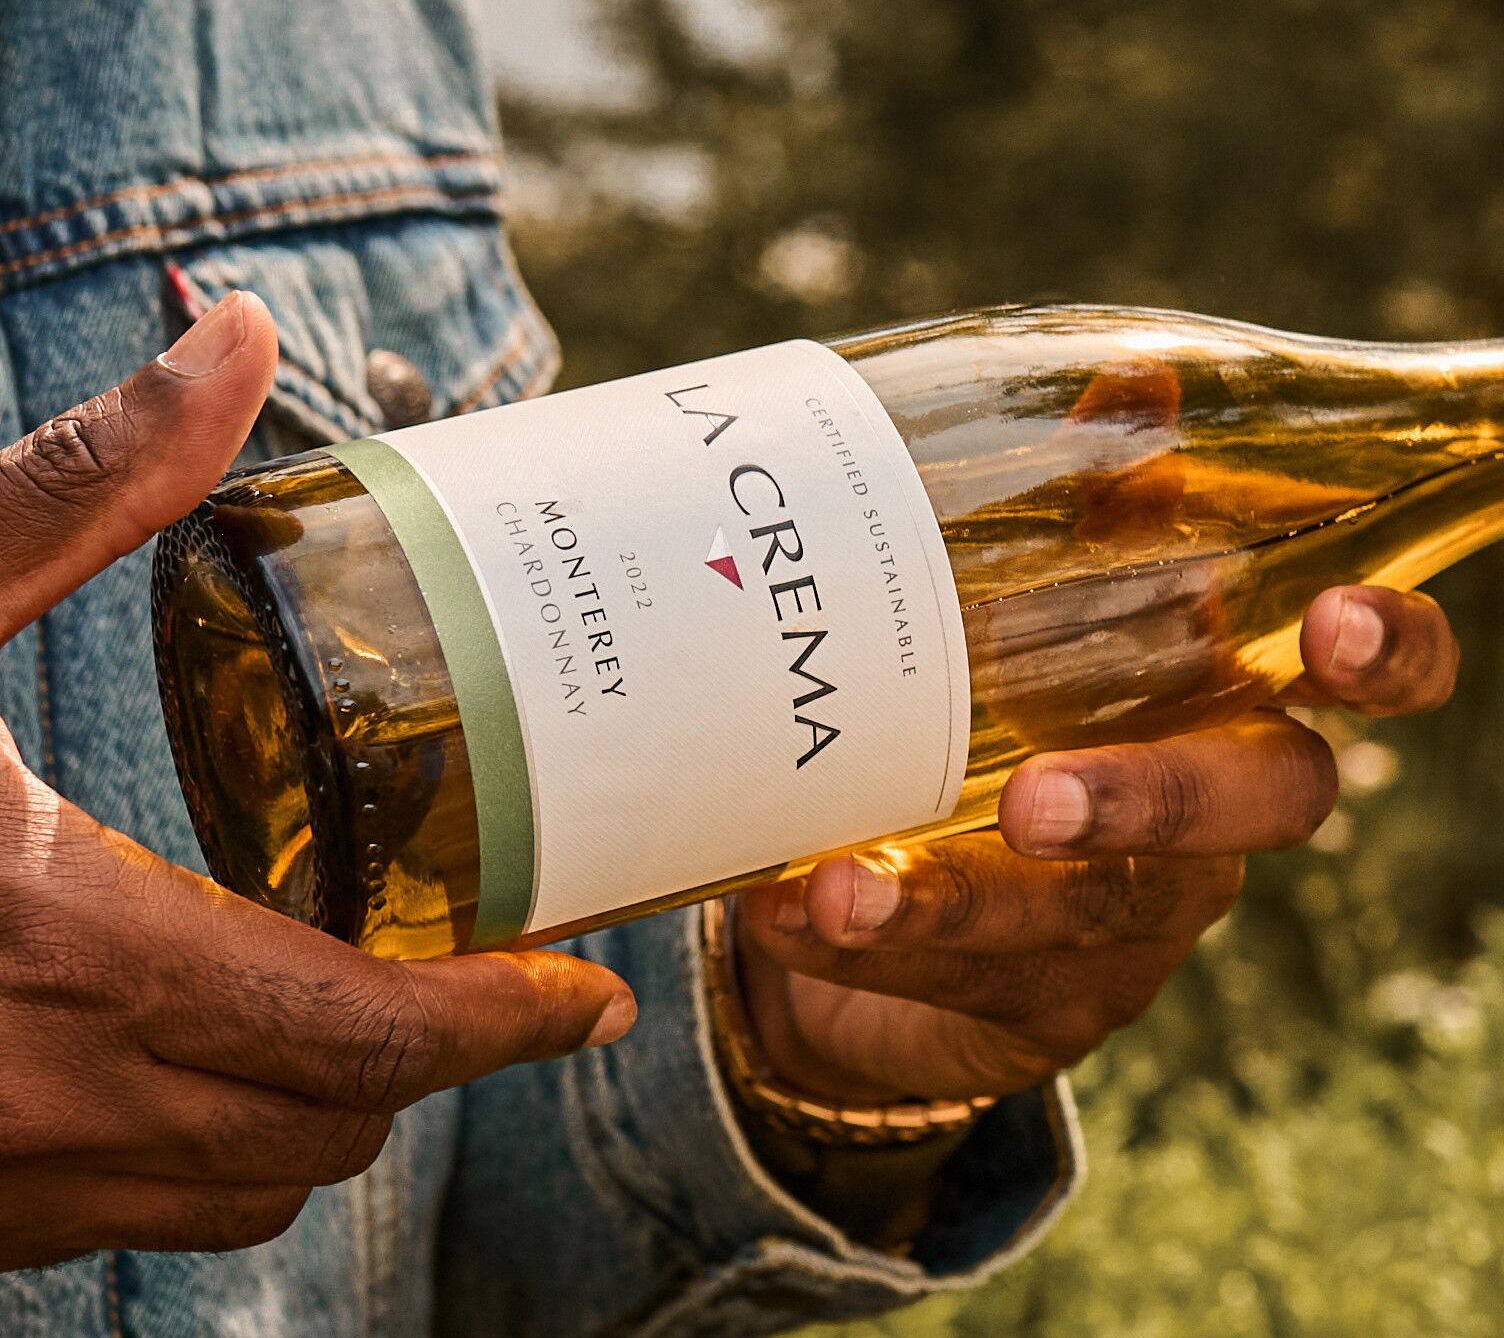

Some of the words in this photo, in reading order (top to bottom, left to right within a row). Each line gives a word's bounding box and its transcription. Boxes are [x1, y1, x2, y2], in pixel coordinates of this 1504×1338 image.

[496, 501, 587, 716] CHARDONNAY
[534, 500, 627, 697] MONTEREY
[619, 551, 653, 610] 2022
[663, 383, 739, 448] LA
[728, 463, 842, 771] CREMA
[805, 397, 869, 497] CERTIFIED
[863, 508, 917, 678] SUSTAINABLE
